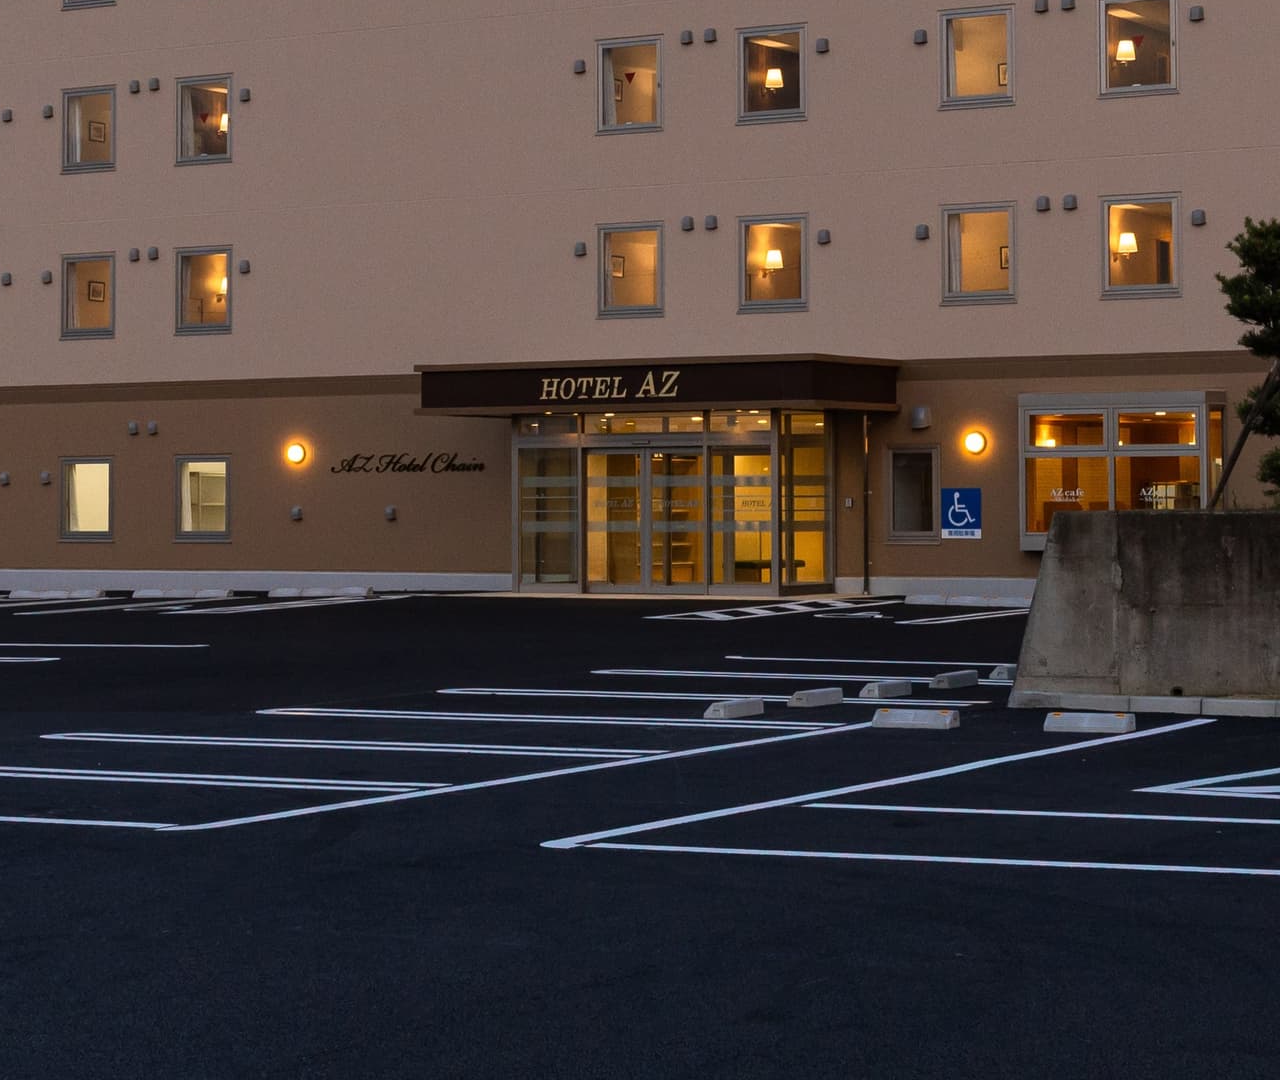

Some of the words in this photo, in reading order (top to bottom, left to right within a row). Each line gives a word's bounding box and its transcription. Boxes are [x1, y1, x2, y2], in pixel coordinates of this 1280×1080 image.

[539, 376, 628, 401] HOTEL
[635, 370, 681, 398] AZ
[331, 453, 375, 473] AZ
[375, 452, 434, 473] Hotel
[431, 453, 485, 474] Chain
